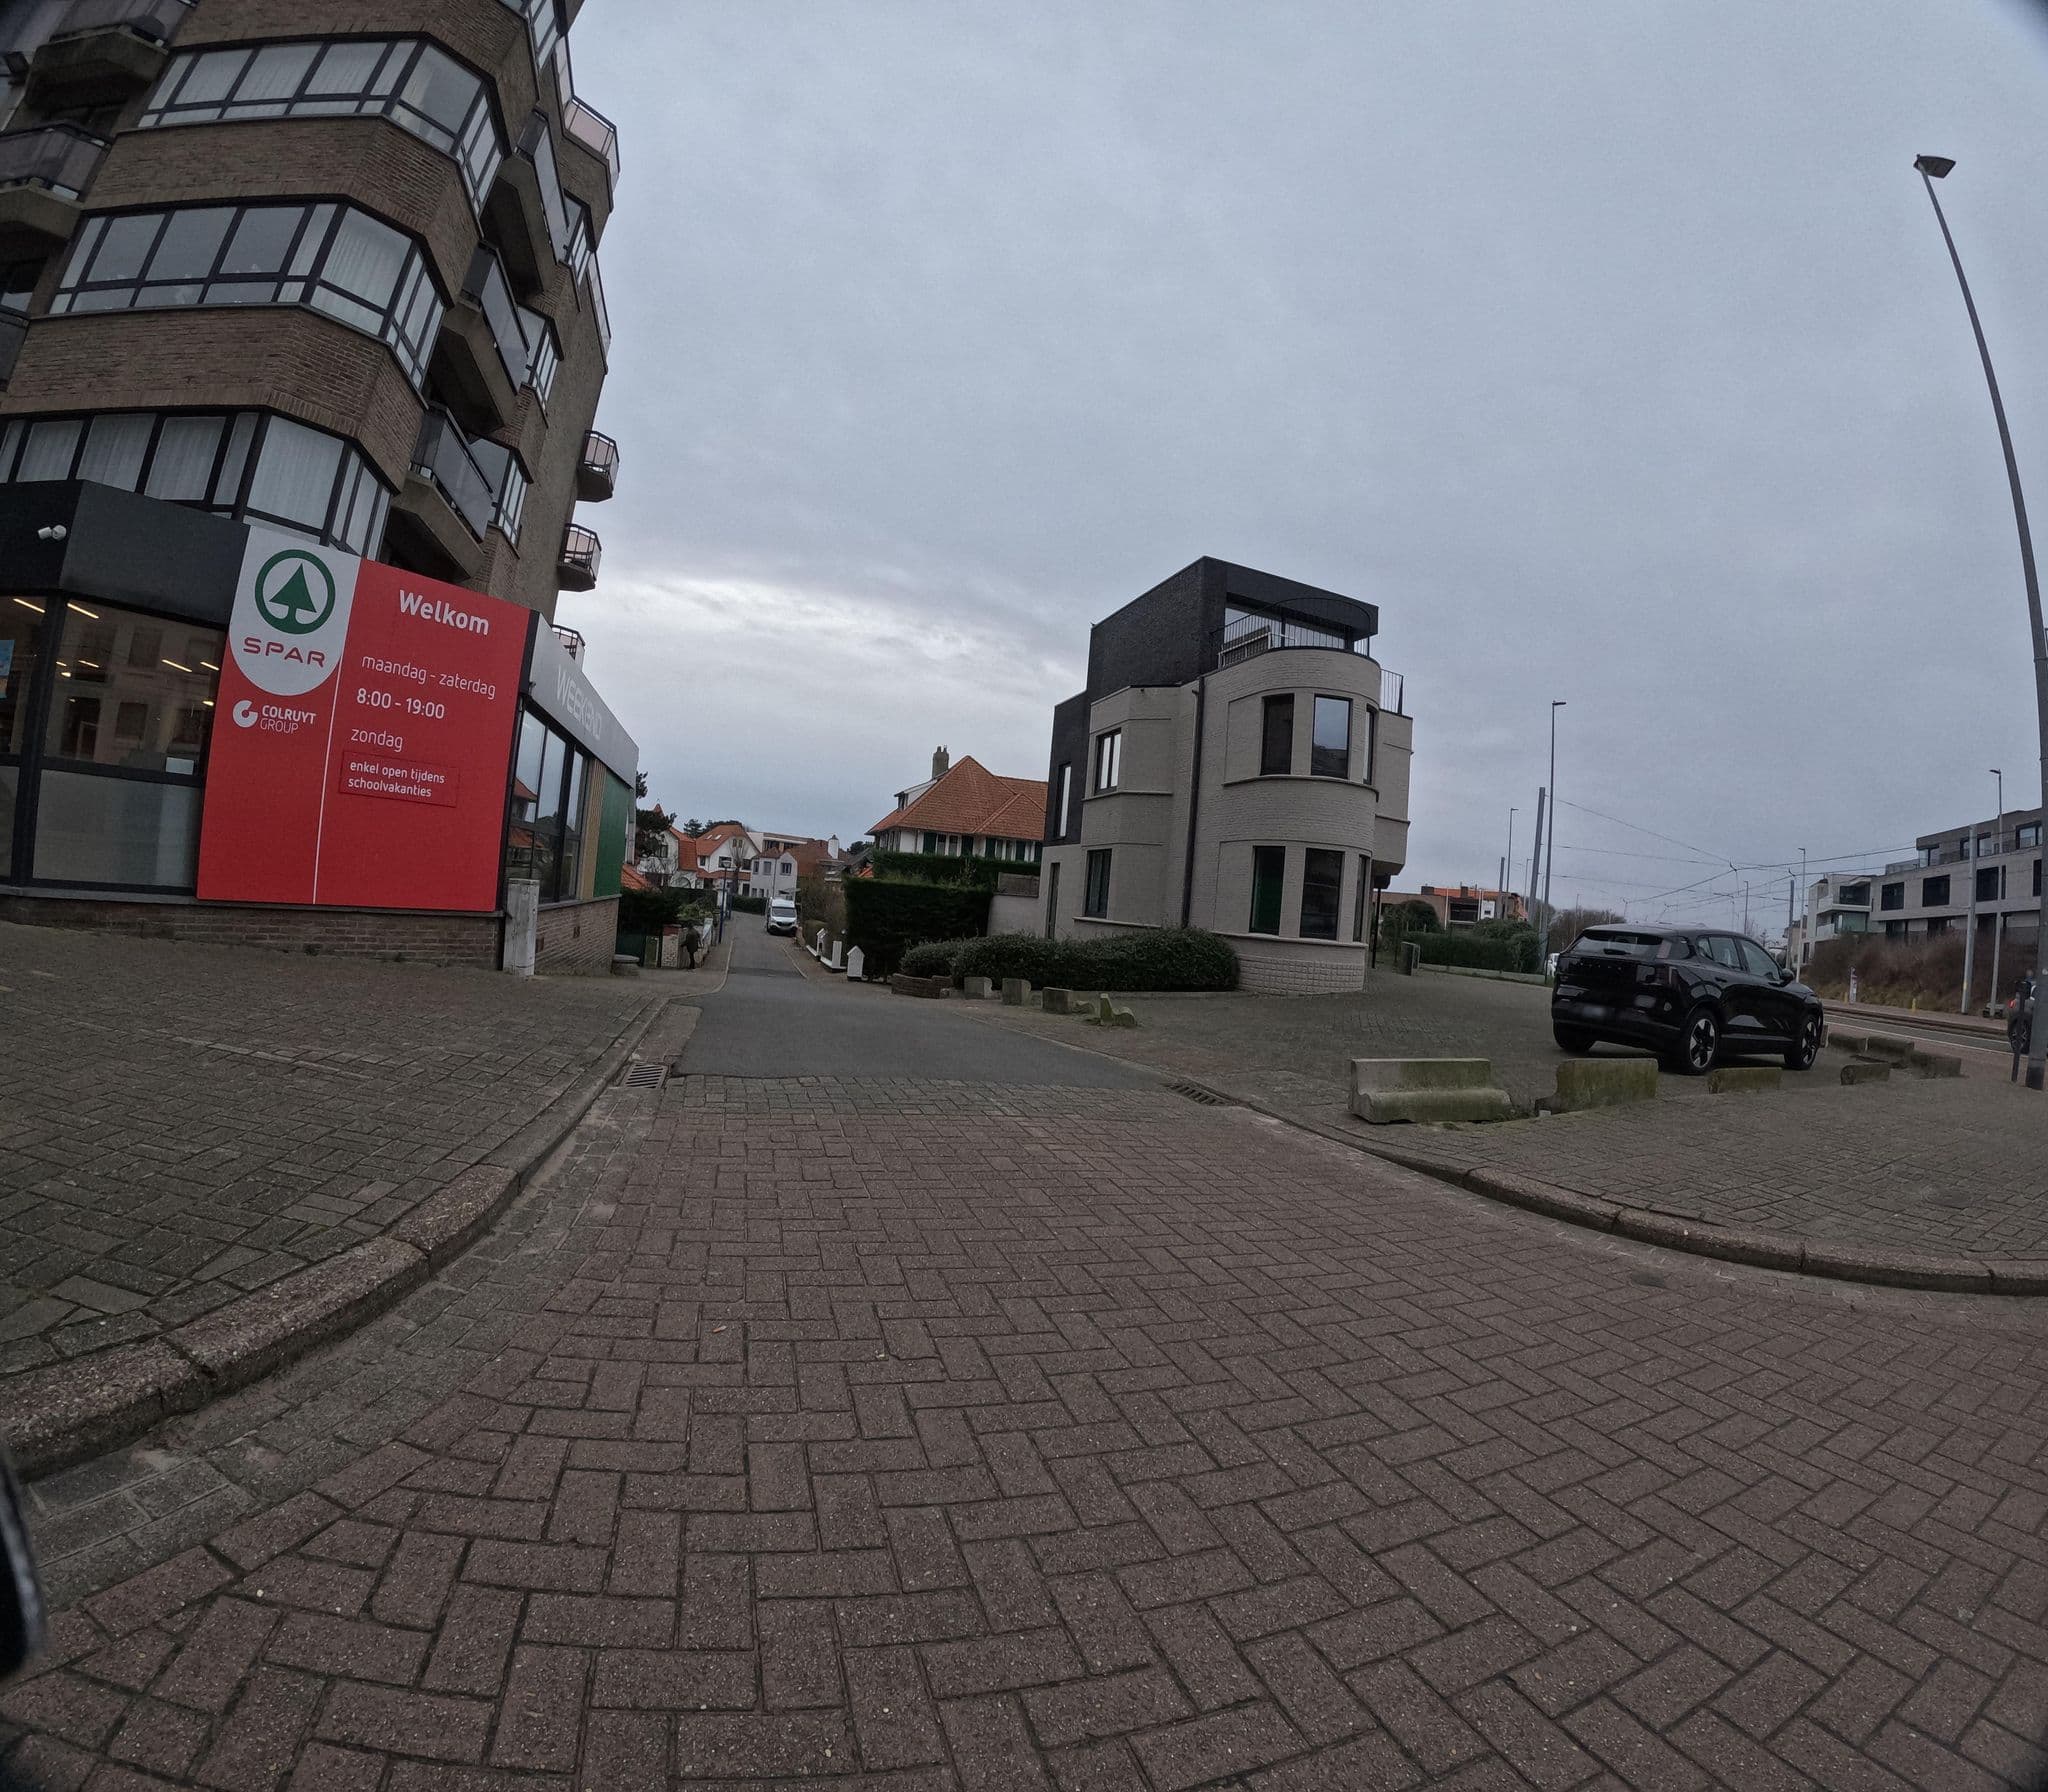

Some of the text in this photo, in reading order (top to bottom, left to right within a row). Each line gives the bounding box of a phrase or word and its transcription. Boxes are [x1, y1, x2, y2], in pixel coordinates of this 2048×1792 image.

[400, 589, 489, 635] Welkom
[243, 637, 325, 668] SPAR
[361, 656, 427, 684] maandag
[440, 673, 496, 700] zaterdag
[262, 705, 316, 725] COLRUYT
[357, 688, 391, 709] 8:00
[406, 698, 445, 719] 19:00
[260, 718, 299, 734] GROUP
[350, 728, 403, 752] zondag
[350, 761, 445, 784] enkel open tijdens
[348, 777, 432, 797] schoolvakanties
